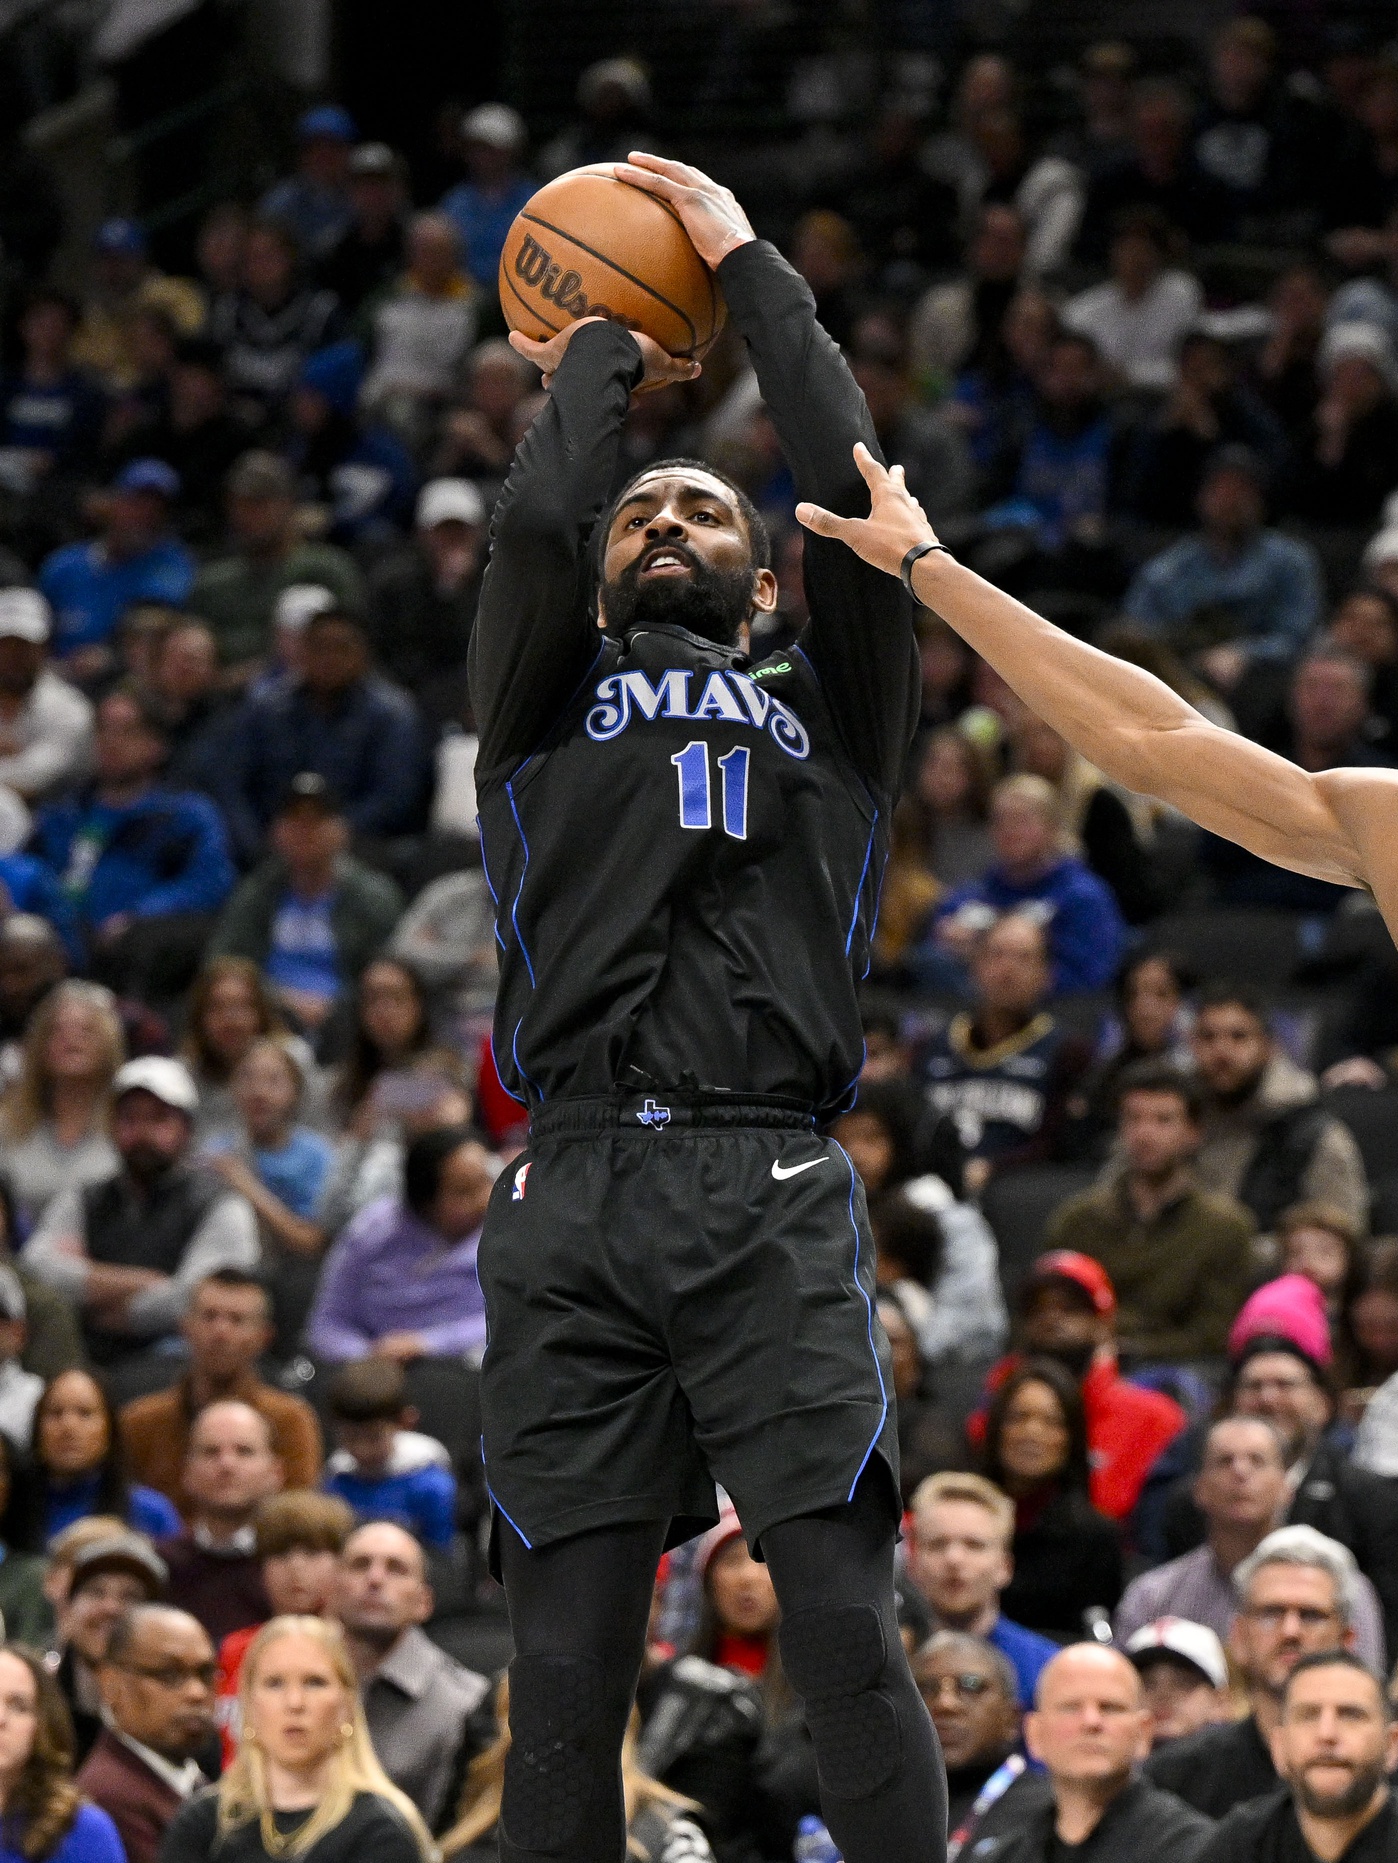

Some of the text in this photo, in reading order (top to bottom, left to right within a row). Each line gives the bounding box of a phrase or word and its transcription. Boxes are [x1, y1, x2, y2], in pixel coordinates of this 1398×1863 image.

[585, 668, 811, 761] MAVS
[748, 662, 792, 680] ime
[670, 740, 751, 841] 11
